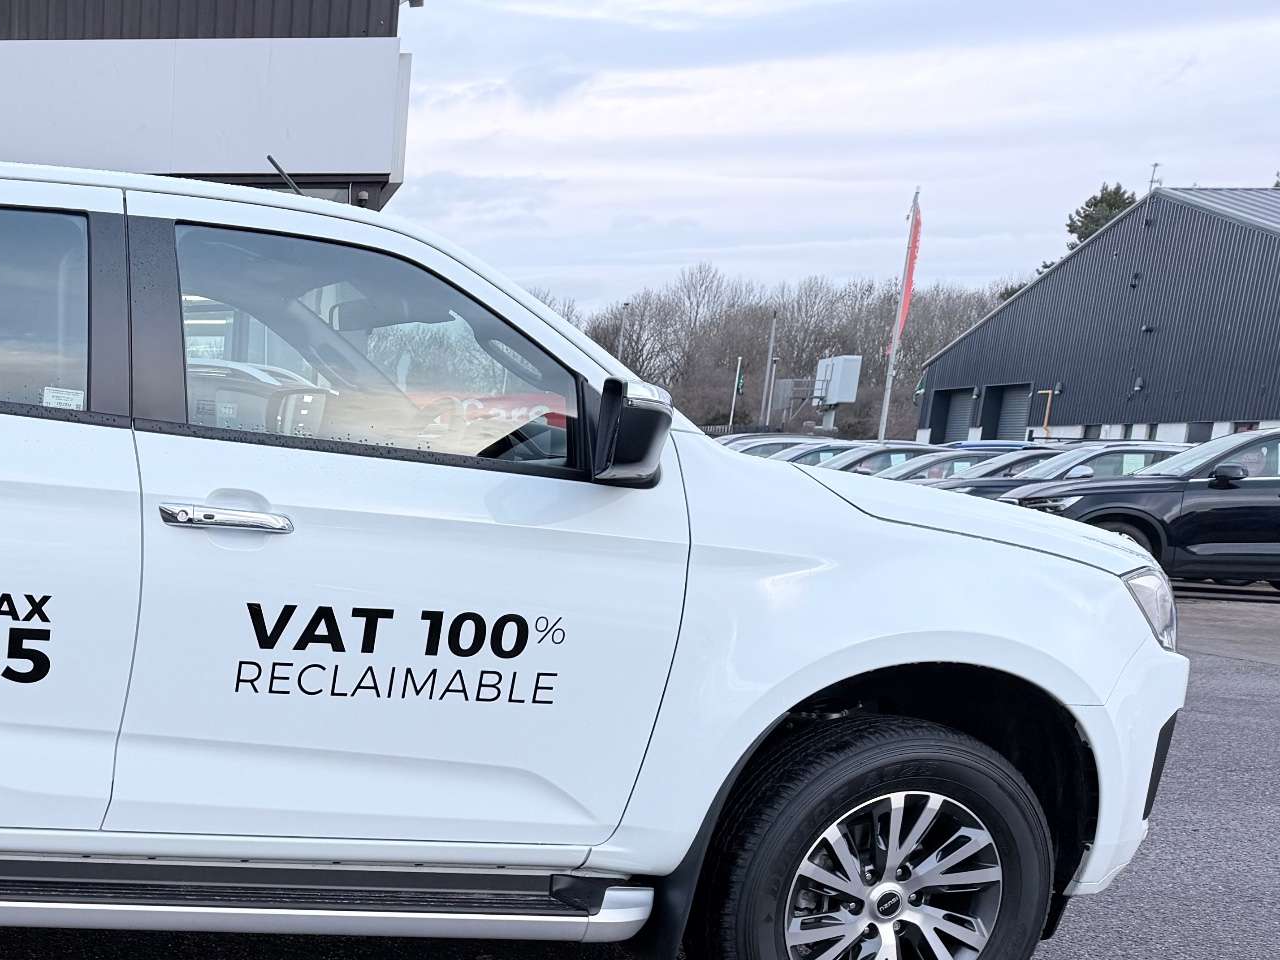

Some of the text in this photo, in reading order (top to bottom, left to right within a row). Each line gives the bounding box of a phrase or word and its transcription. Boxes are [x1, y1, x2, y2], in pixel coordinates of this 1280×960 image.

[246, 602, 566, 659] VAT 100%
[234, 660, 559, 705] RECLAIMABLE
